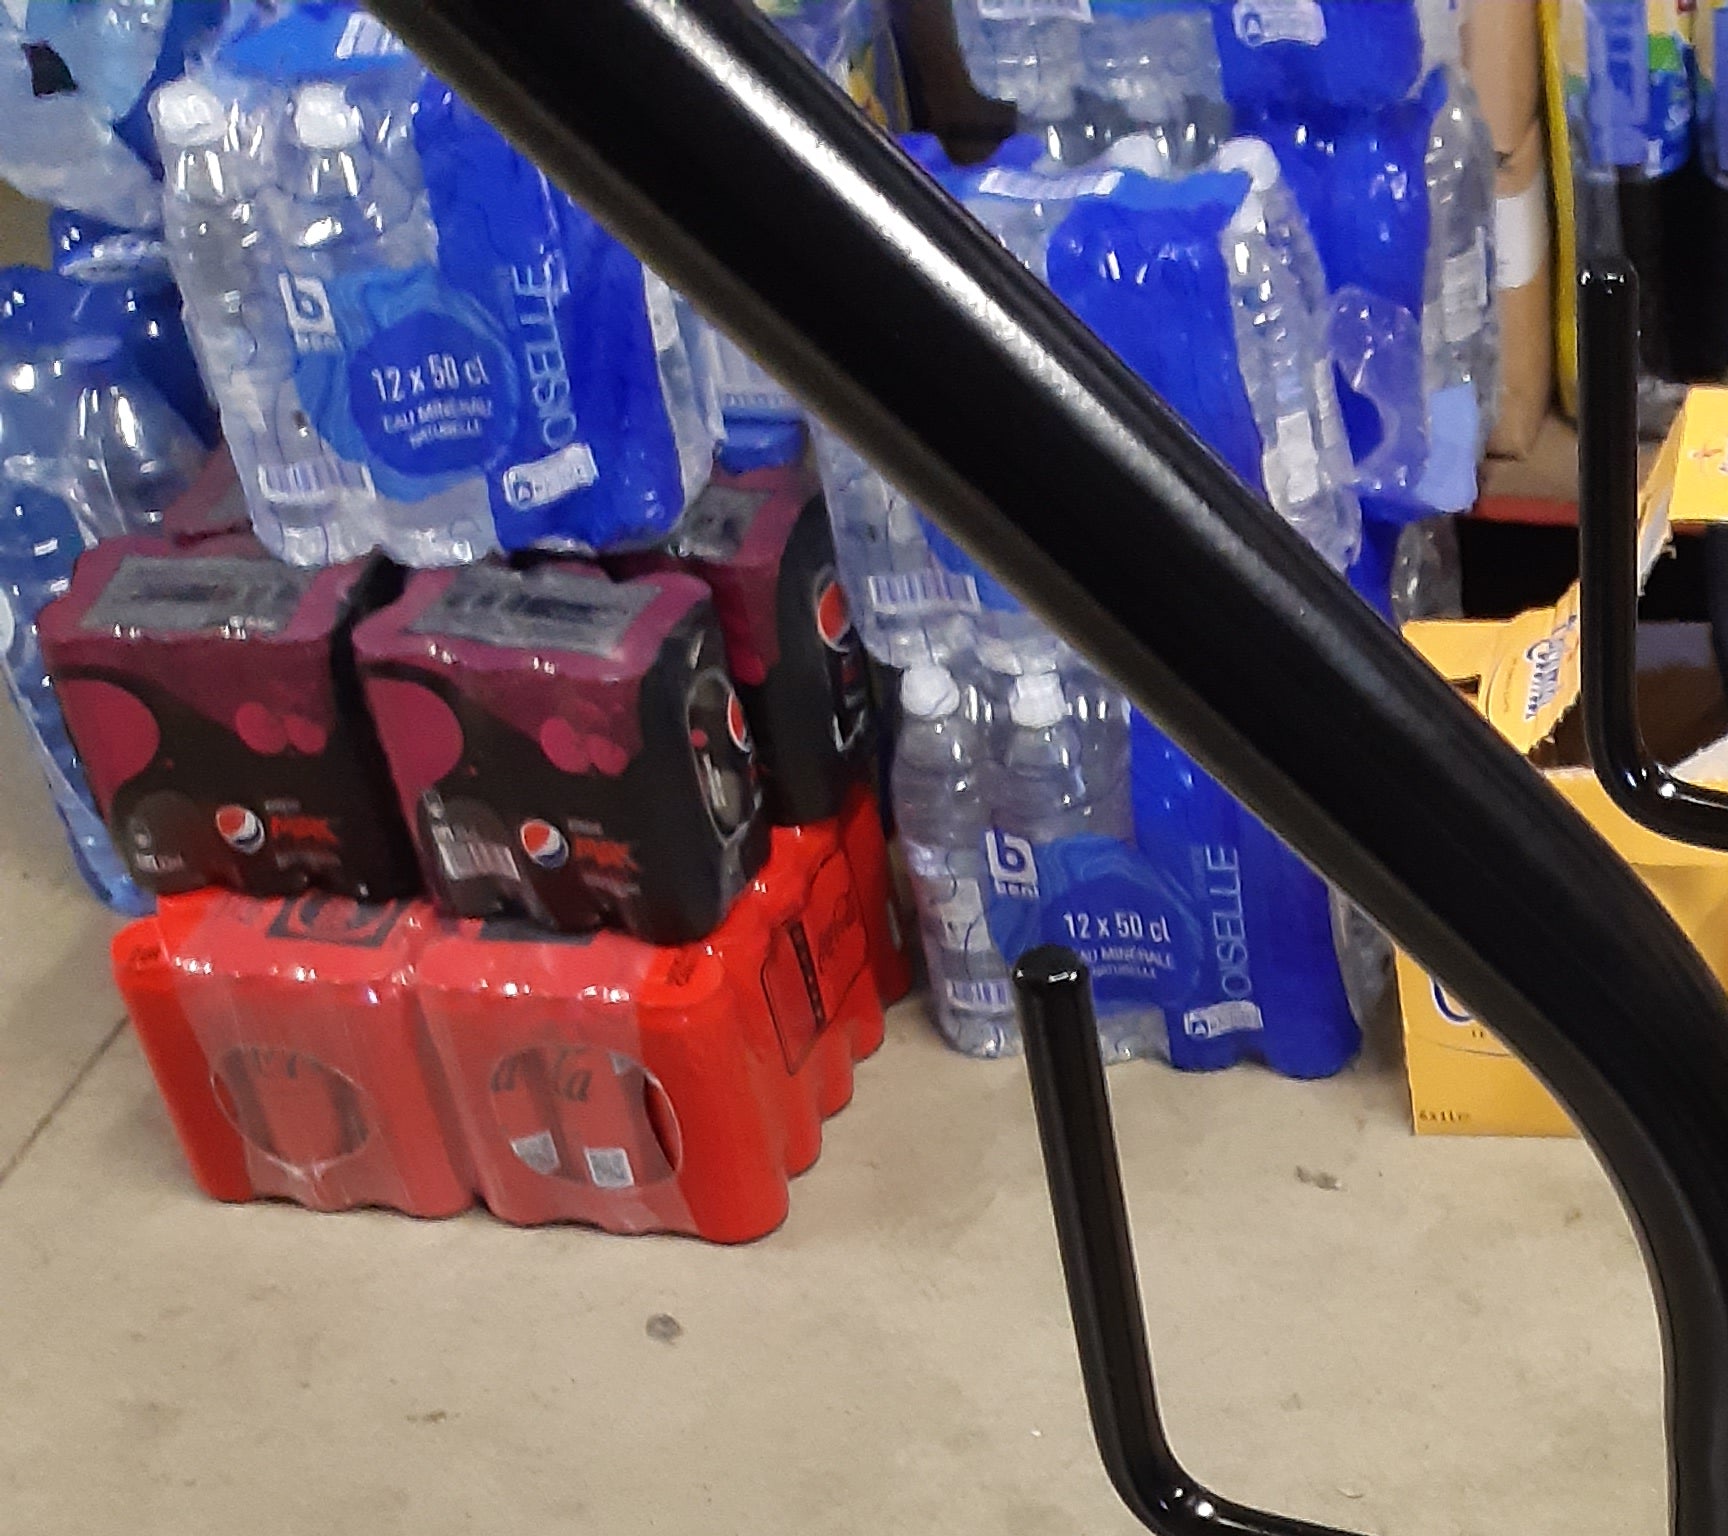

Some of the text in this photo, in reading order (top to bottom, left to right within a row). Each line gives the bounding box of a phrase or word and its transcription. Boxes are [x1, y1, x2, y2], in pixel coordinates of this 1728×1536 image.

[371, 365, 405, 402] 12
[409, 365, 426, 396] x
[428, 352, 460, 390] 50
[1063, 909, 1172, 944] 12 x 50 cl
